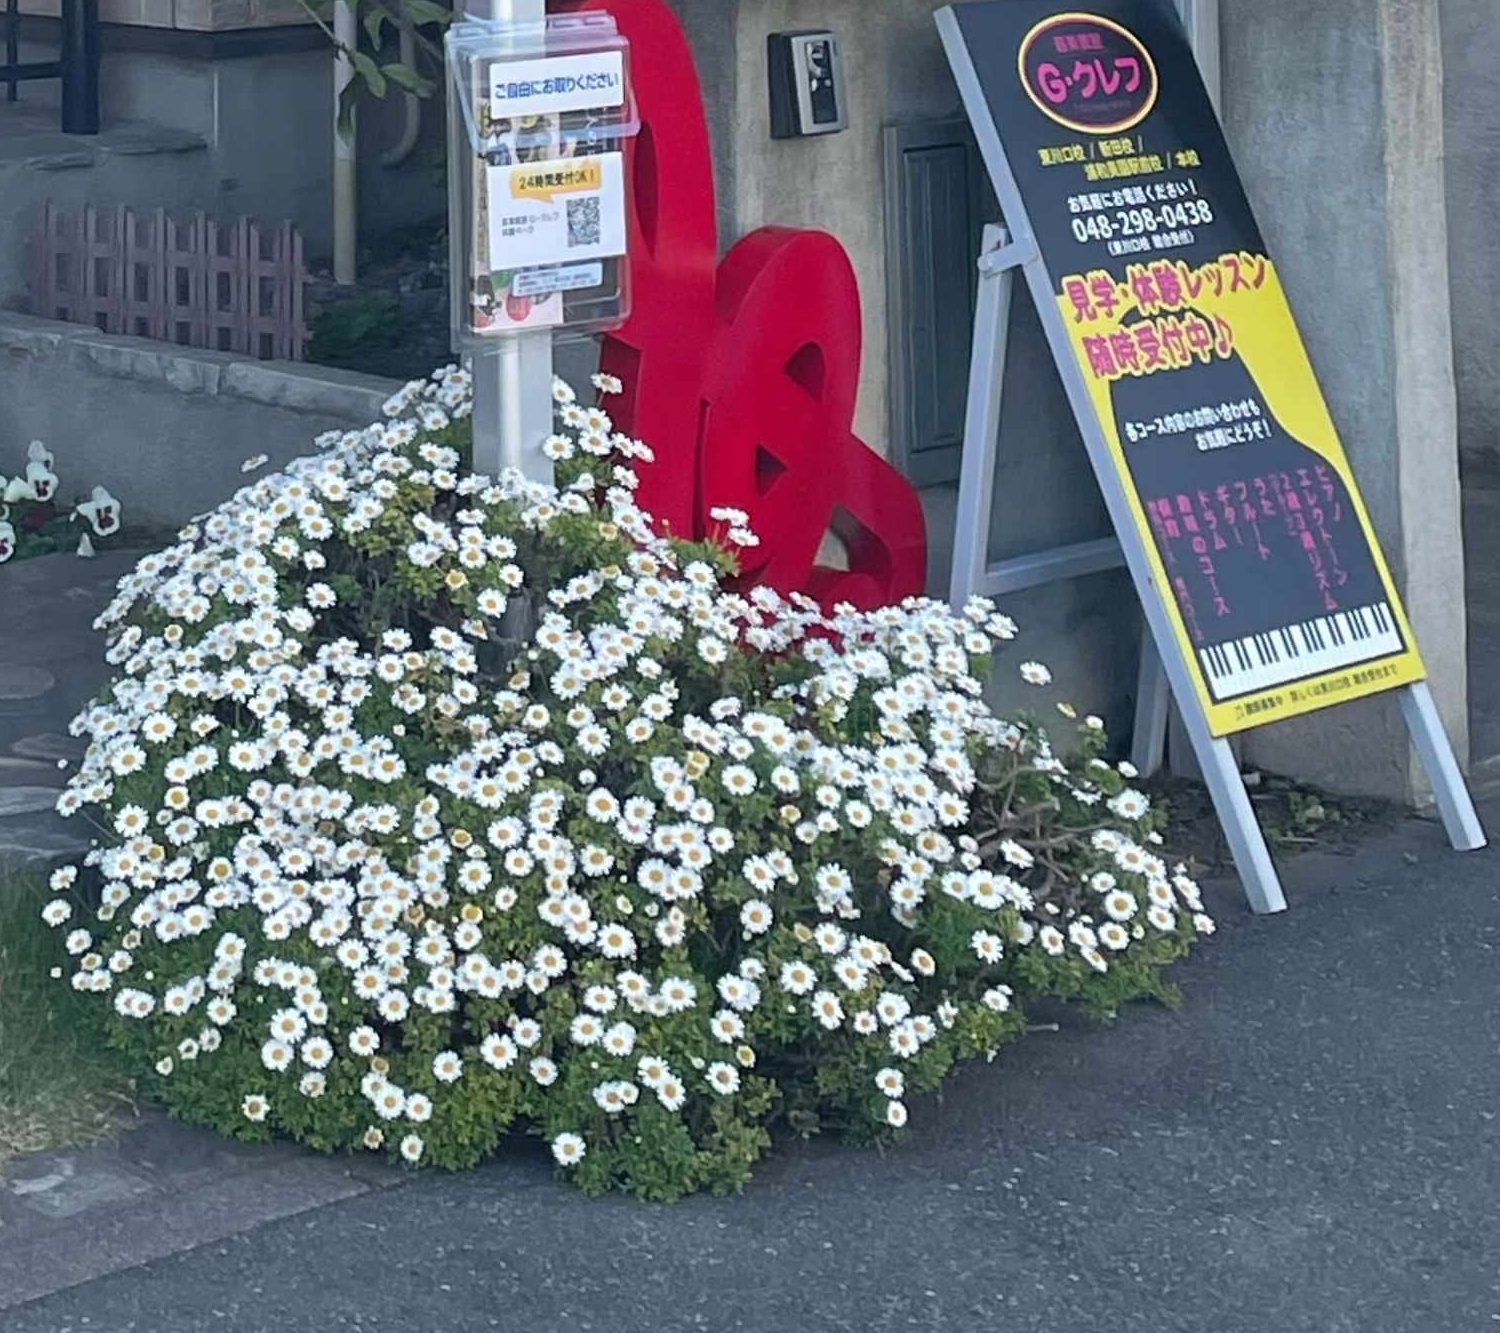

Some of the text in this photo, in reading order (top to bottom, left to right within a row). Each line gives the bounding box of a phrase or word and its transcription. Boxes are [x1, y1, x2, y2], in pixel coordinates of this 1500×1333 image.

[494, 72, 620, 100] ご自由にお取りください
[1071, 199, 1214, 243] 048-298-0438
[1064, 252, 1267, 324] 見学・体験レッスン
